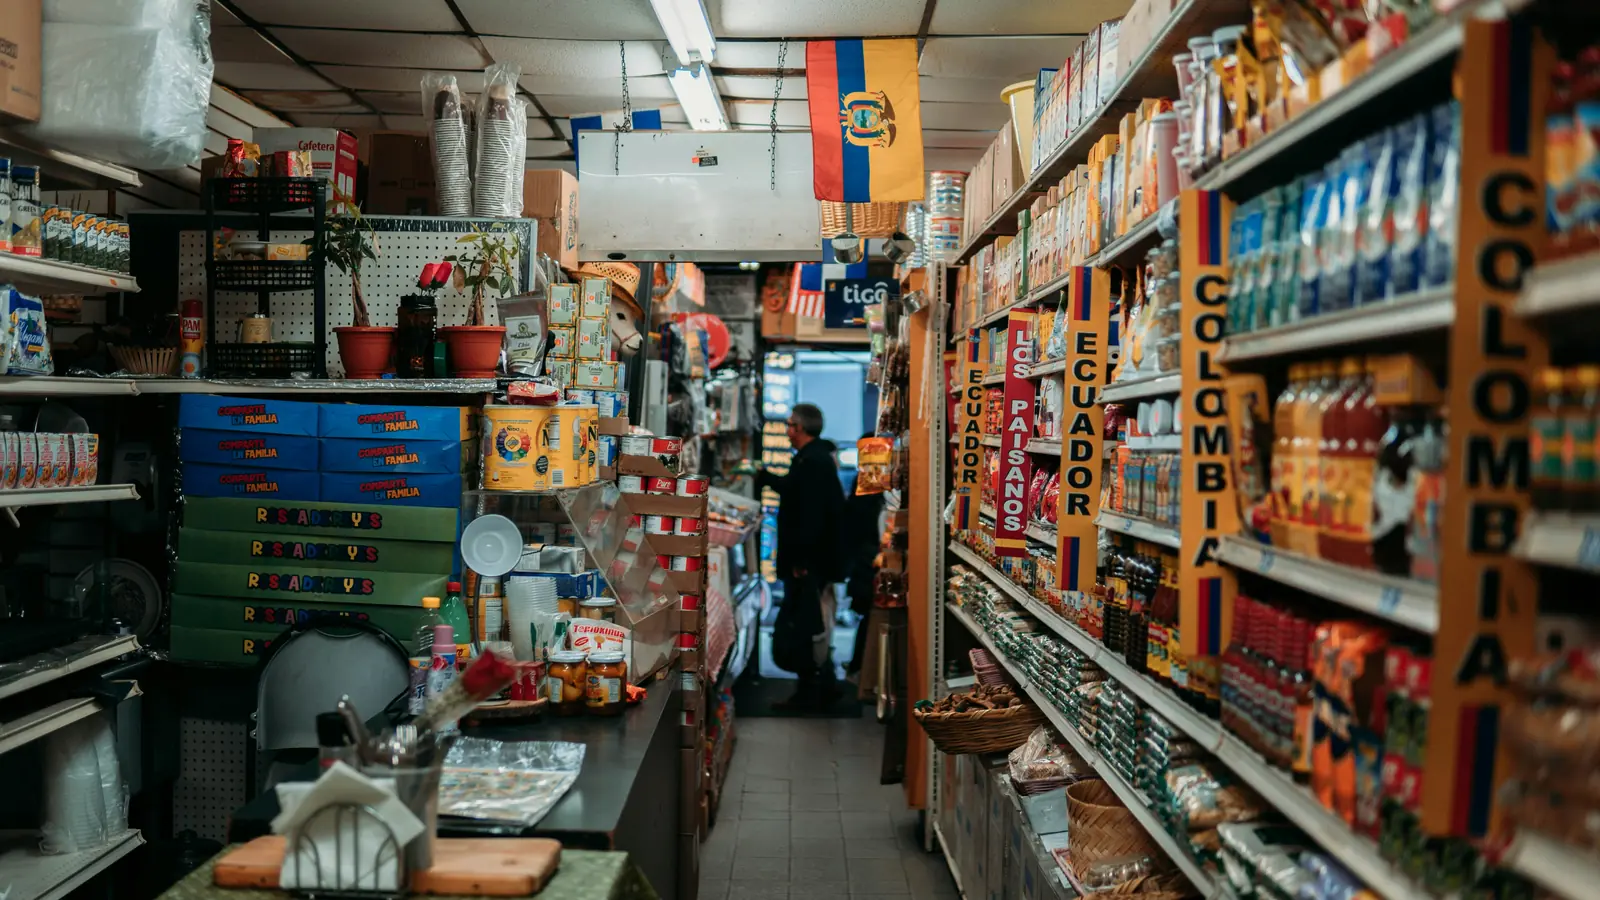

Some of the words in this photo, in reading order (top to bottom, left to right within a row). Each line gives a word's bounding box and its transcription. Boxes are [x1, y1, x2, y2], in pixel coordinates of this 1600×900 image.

[298, 140, 335, 151] Cafetera
[843, 282, 888, 304] tigo
[182, 319, 200, 332] PAM
[1013, 330, 1031, 379] LOS
[218, 405, 265, 416] COMPARTE
[245, 414, 278, 424] FAMILIA
[358, 411, 405, 424] COMPARTE
[1067, 332, 1098, 516] ECUADOR
[1192, 275, 1230, 567] COLOMBIA
[385, 420, 418, 432] FAMILIA
[962, 369, 983, 484] ECUADOR
[1456, 171, 1537, 685] COLOMBIA
[219, 439, 265, 450] COMPARTE
[358, 445, 405, 457] COMPARTE
[245, 448, 278, 458] FAMILIA
[385, 453, 418, 465] FAMILIA
[220, 473, 266, 483] COMPARTE
[360, 478, 406, 491] COMPARTE
[656, 479, 671, 488] Pure
[246, 482, 278, 492] FAMILIA
[387, 487, 420, 499] FAMILIA
[256, 507, 308, 525] RSA
[252, 541, 304, 559] RSA
[248, 573, 300, 591] RSA
[244, 606, 296, 624] RSA
